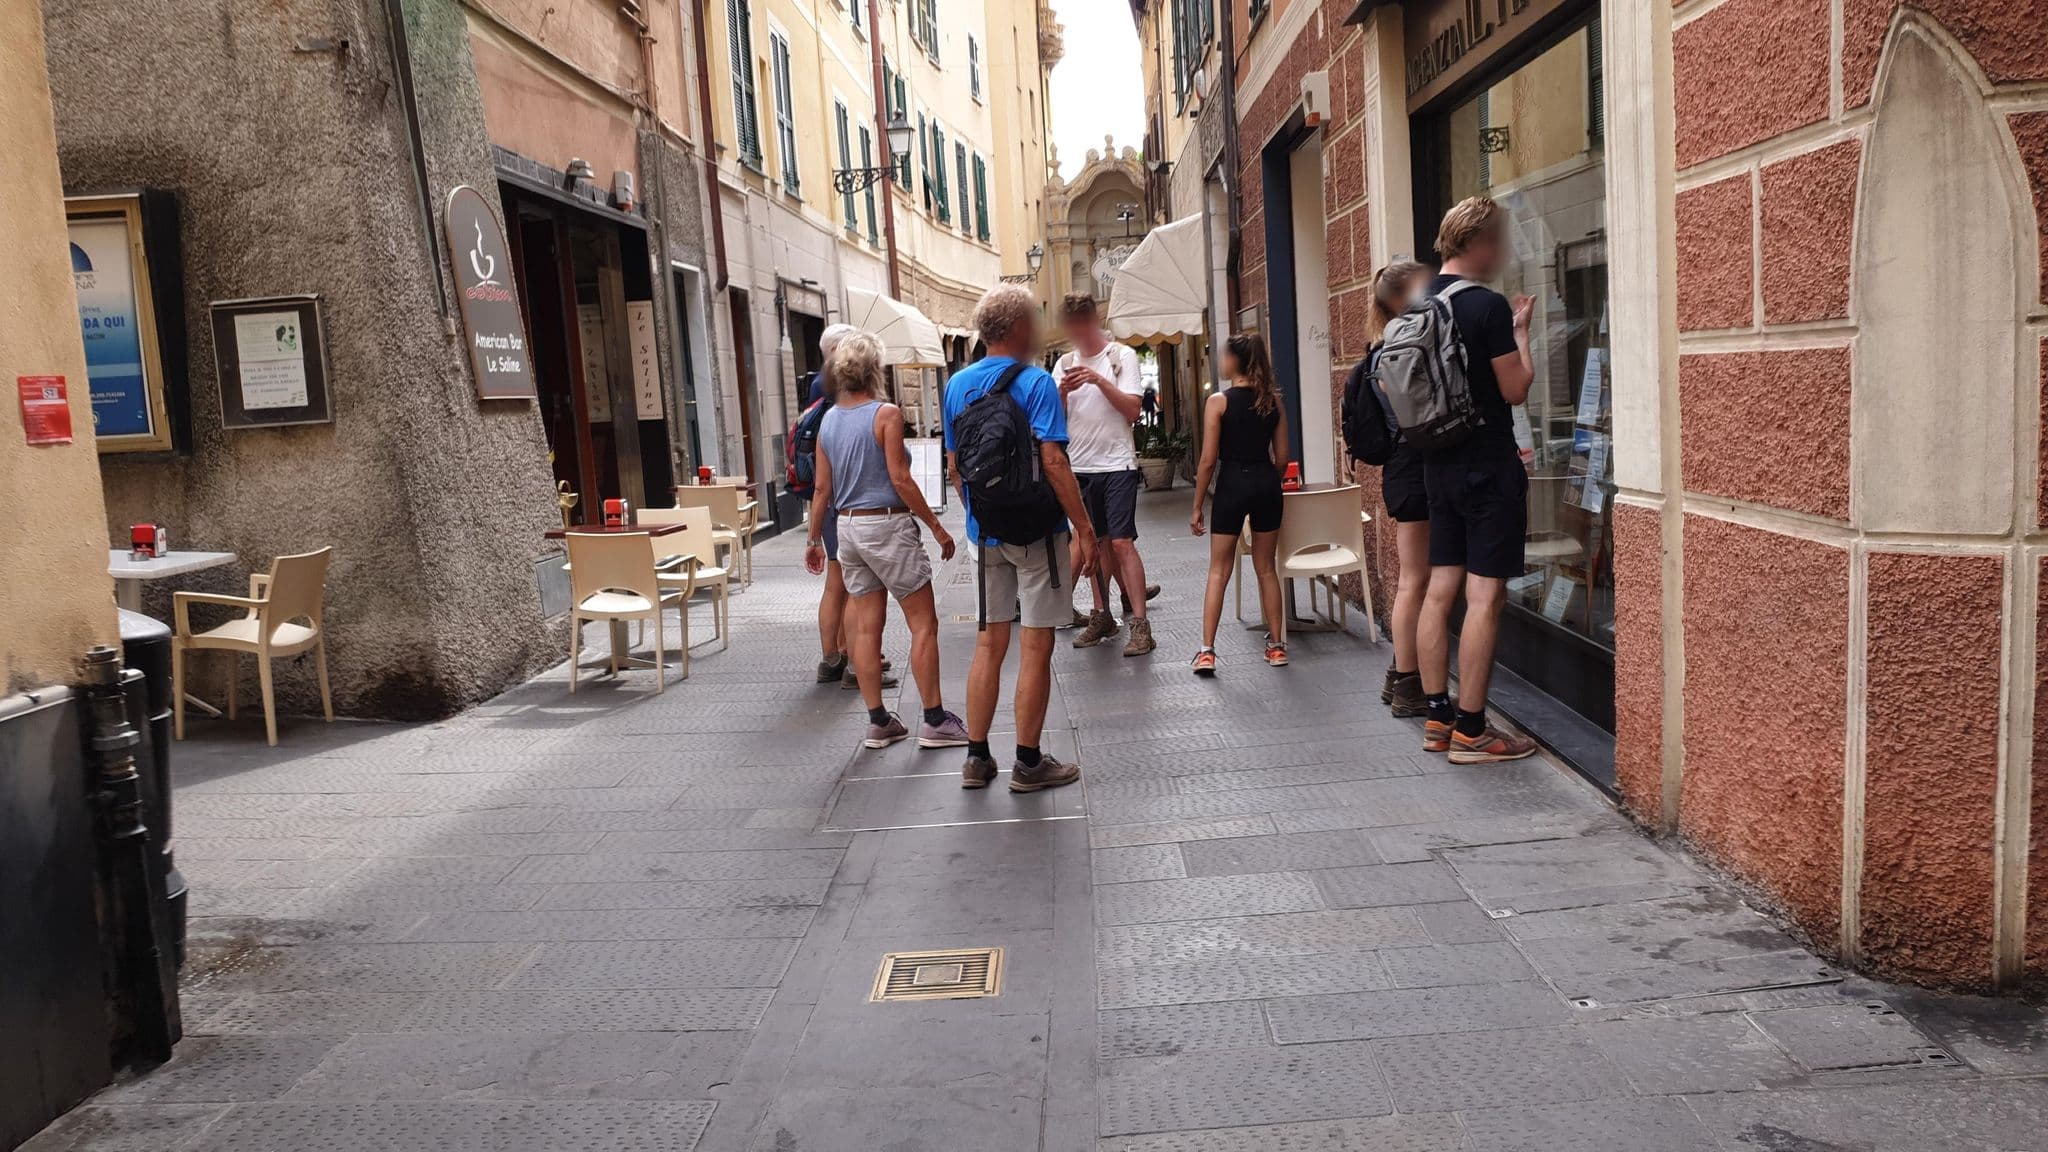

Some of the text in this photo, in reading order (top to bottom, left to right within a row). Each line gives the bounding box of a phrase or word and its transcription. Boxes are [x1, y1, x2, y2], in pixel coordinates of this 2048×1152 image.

[83, 316, 125, 329] DA QUI
[475, 331, 522, 350] American Bar
[486, 355, 521, 373] Le Saline
[640, 345, 654, 410] Saline
